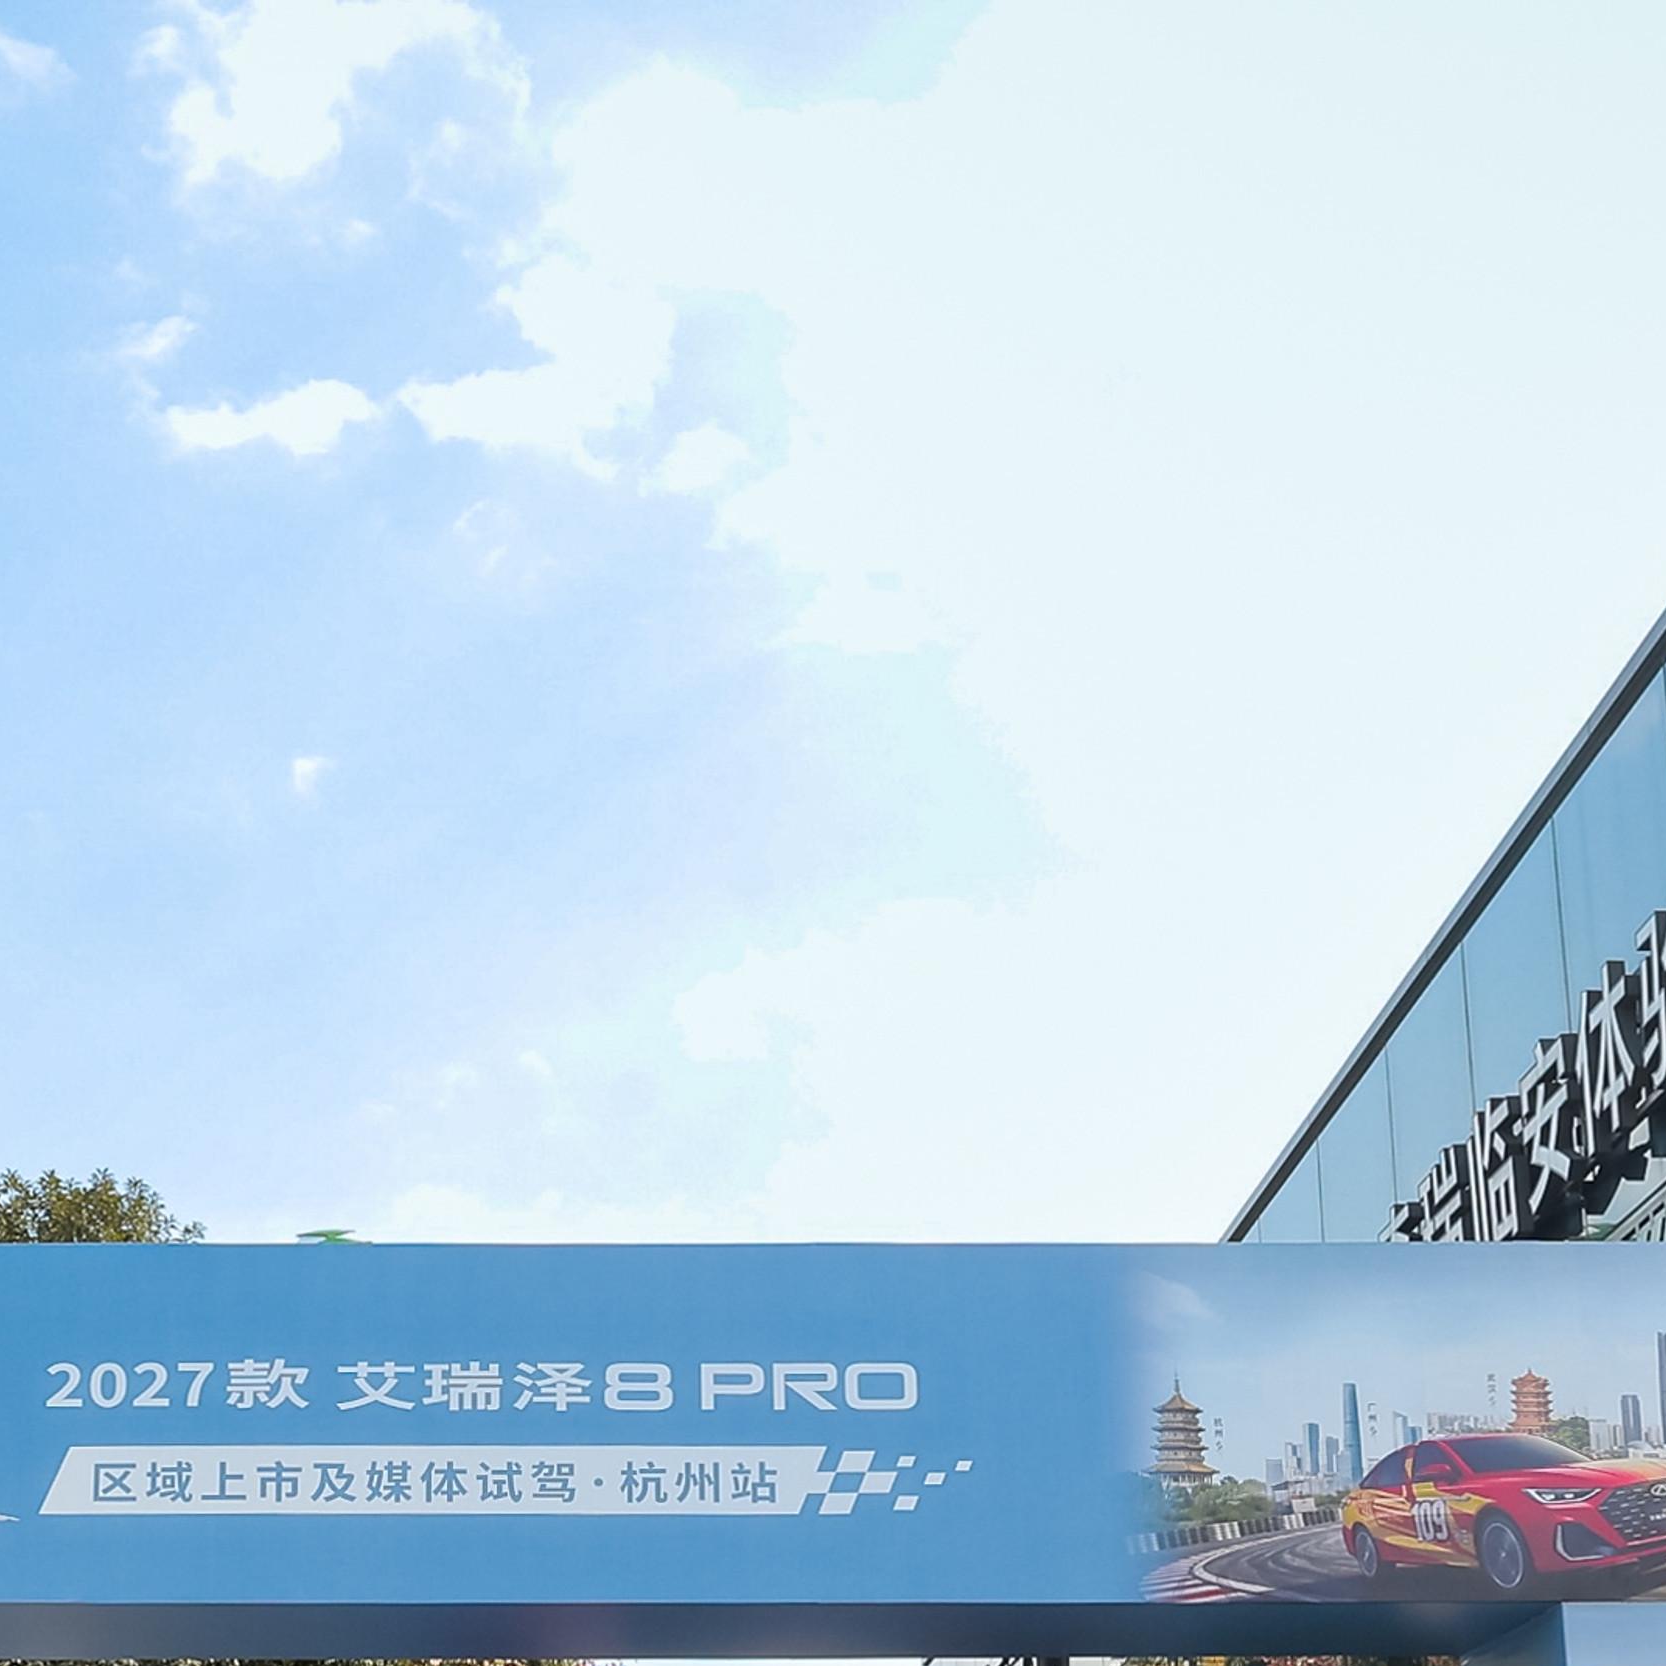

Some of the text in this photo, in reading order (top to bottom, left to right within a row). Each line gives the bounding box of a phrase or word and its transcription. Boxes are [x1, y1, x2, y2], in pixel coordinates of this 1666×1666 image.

[46, 1359, 918, 1412] 2027款 艾瑞泽8 PRO
[93, 1460, 779, 1504] 区域上市及媒体试驾·杭州站
[1413, 1499, 1450, 1541] 109
